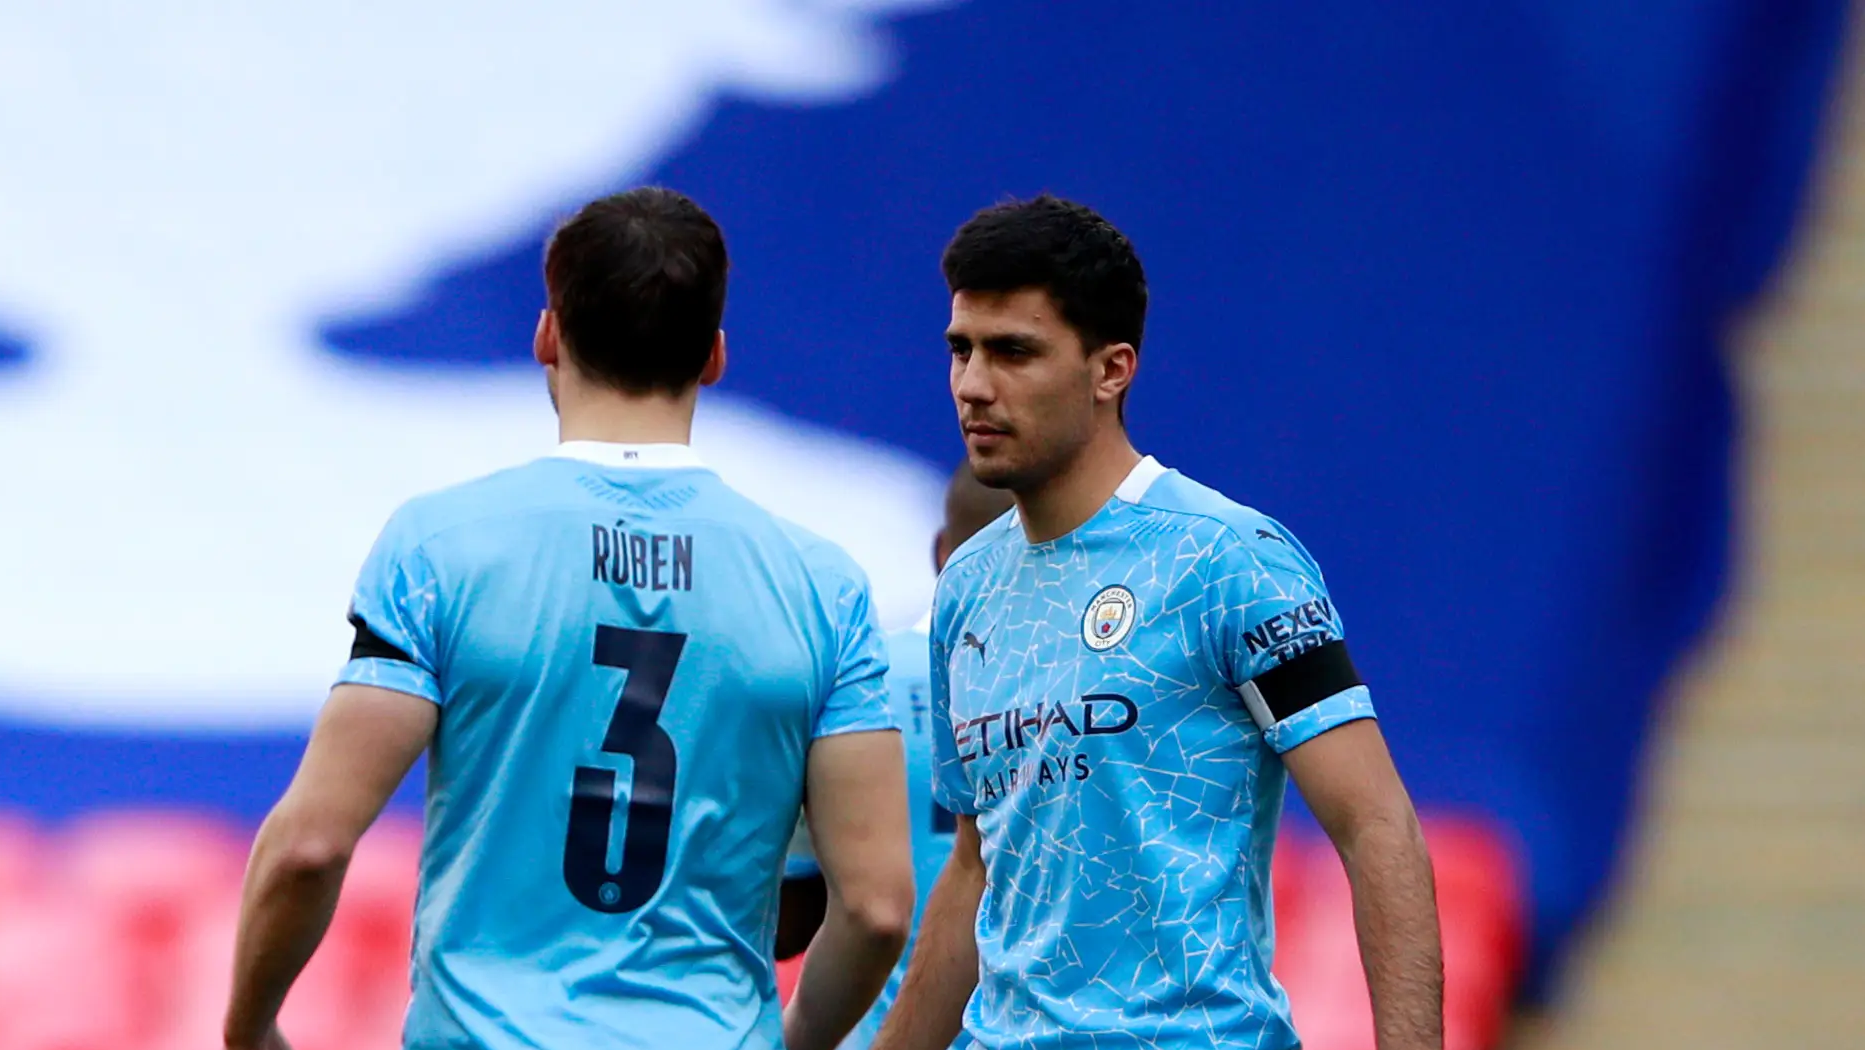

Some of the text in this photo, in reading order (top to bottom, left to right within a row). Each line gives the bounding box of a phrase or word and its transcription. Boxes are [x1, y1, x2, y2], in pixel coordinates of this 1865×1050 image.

[592, 519, 692, 591] RÚBEN
[955, 693, 1138, 764] ETIHAD
[563, 624, 688, 914] 3
[983, 753, 1090, 802] AIRWAYS
